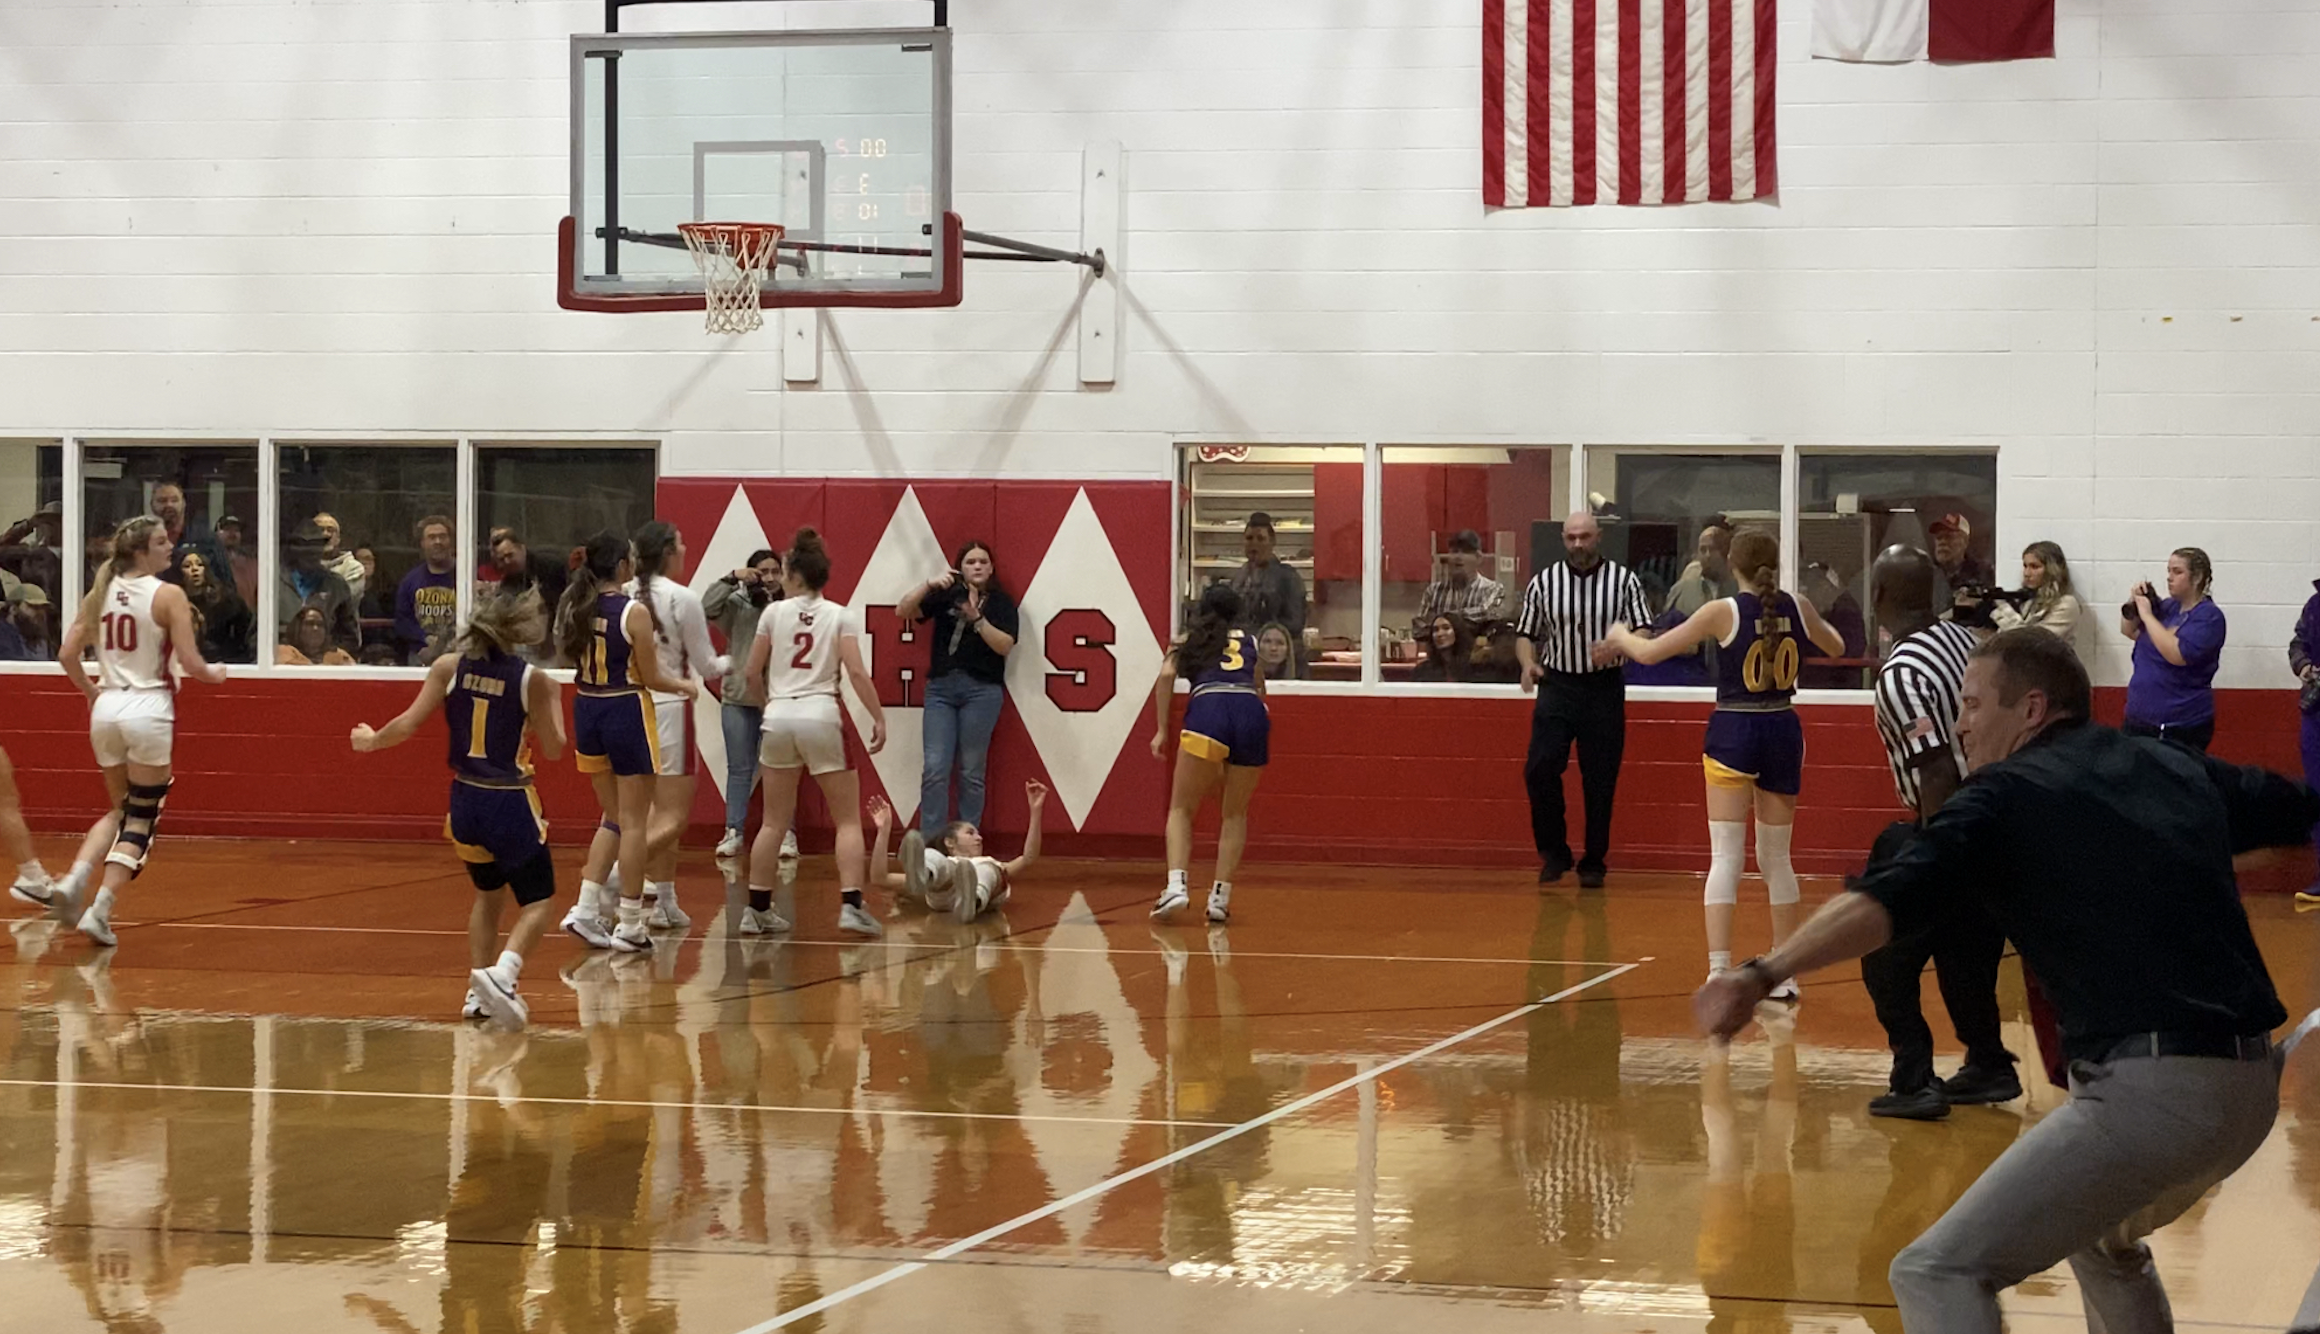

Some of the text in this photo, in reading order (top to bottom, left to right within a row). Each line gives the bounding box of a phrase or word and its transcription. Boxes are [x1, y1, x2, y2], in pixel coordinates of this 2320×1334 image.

[415, 587, 456, 604] OZONA
[102, 611, 138, 652] 10
[791, 632, 814, 669] 2
[1044, 608, 1117, 712] S
[1220, 639, 1244, 671] 3
[1742, 637, 1799, 693] 00
[467, 696, 488, 758] 1
